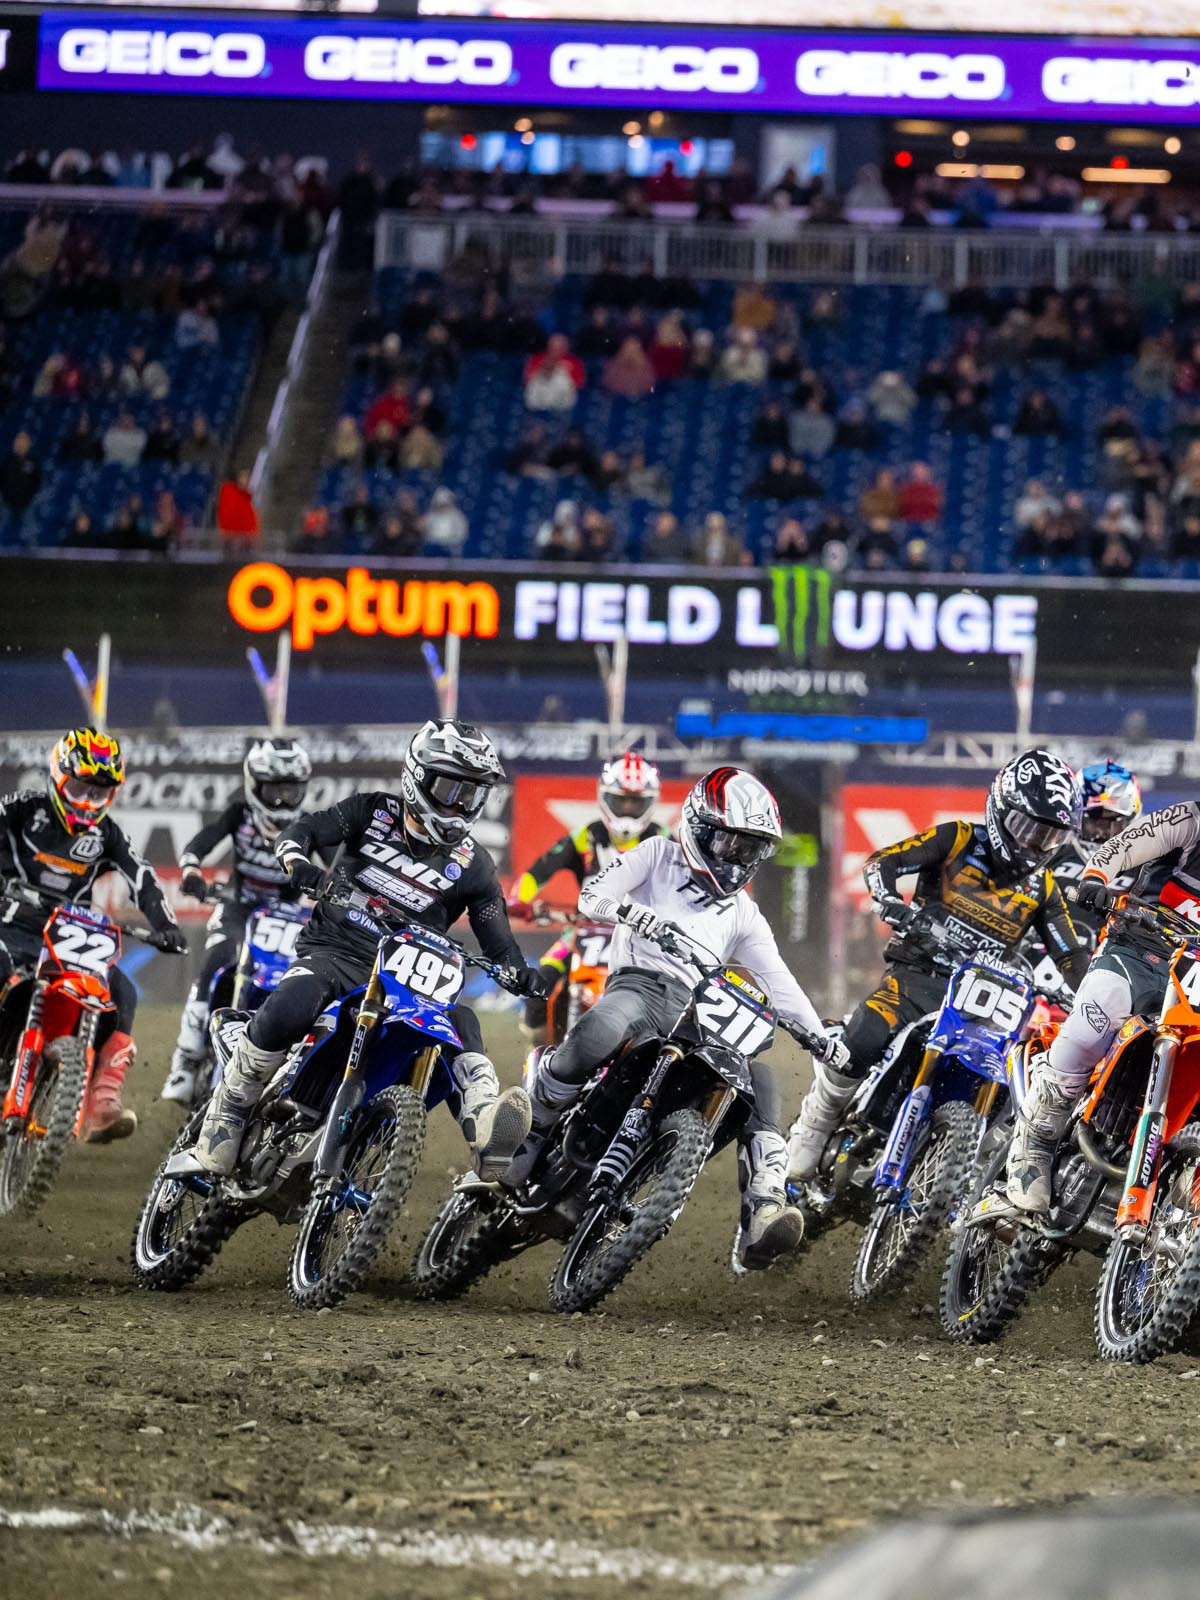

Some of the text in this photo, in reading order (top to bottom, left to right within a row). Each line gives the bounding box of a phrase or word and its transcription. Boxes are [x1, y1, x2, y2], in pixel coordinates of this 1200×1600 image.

[59, 30, 265, 77] GEICO
[305, 36, 512, 84] GEICO
[550, 44, 758, 92] GEICO
[796, 51, 1005, 100] GEICO
[227, 562, 499, 650] Optum
[514, 580, 720, 644] FIELD
[126, 772, 230, 808] OCKY
[1151, 804, 1193, 827] Troy
[357, 874, 427, 912] PERFORMANCE
[51, 923, 118, 978] 22
[383, 943, 464, 1003] 492
[695, 985, 774, 1057] 211
[952, 976, 1029, 1033] 105
[1141, 1121, 1160, 1187] DUNLOP
